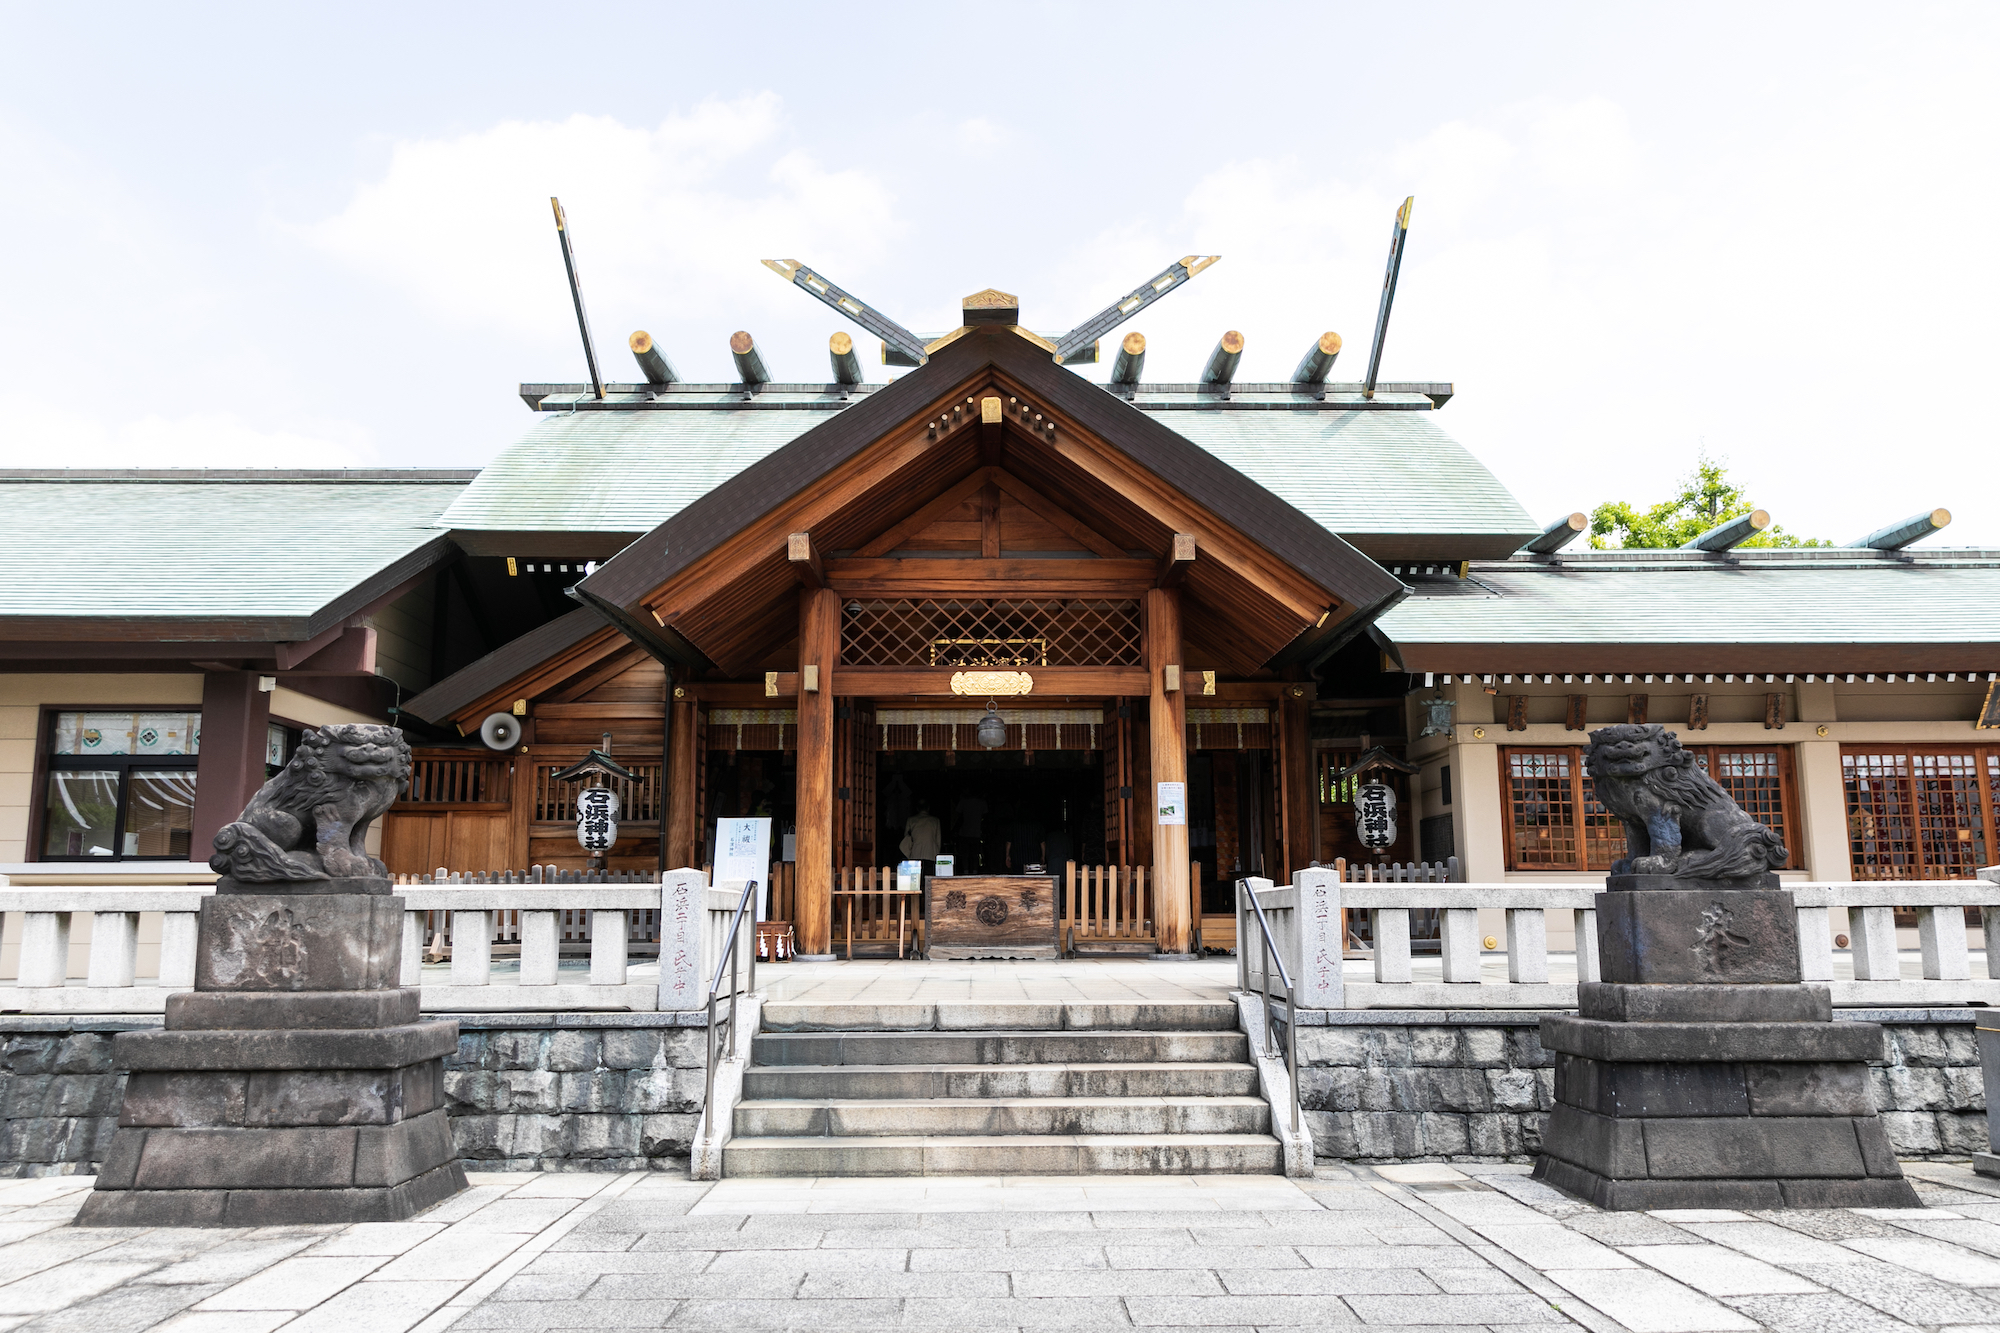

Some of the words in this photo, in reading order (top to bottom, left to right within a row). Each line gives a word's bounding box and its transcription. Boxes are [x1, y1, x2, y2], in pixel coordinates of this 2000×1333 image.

[584, 788, 610, 849] 石浜神社
[1361, 785, 1389, 848] 石浜神社
[672, 882, 690, 944] 石浜二丁目
[1312, 884, 1329, 943] 石浜一丁目
[1316, 948, 1336, 994] 氏子中
